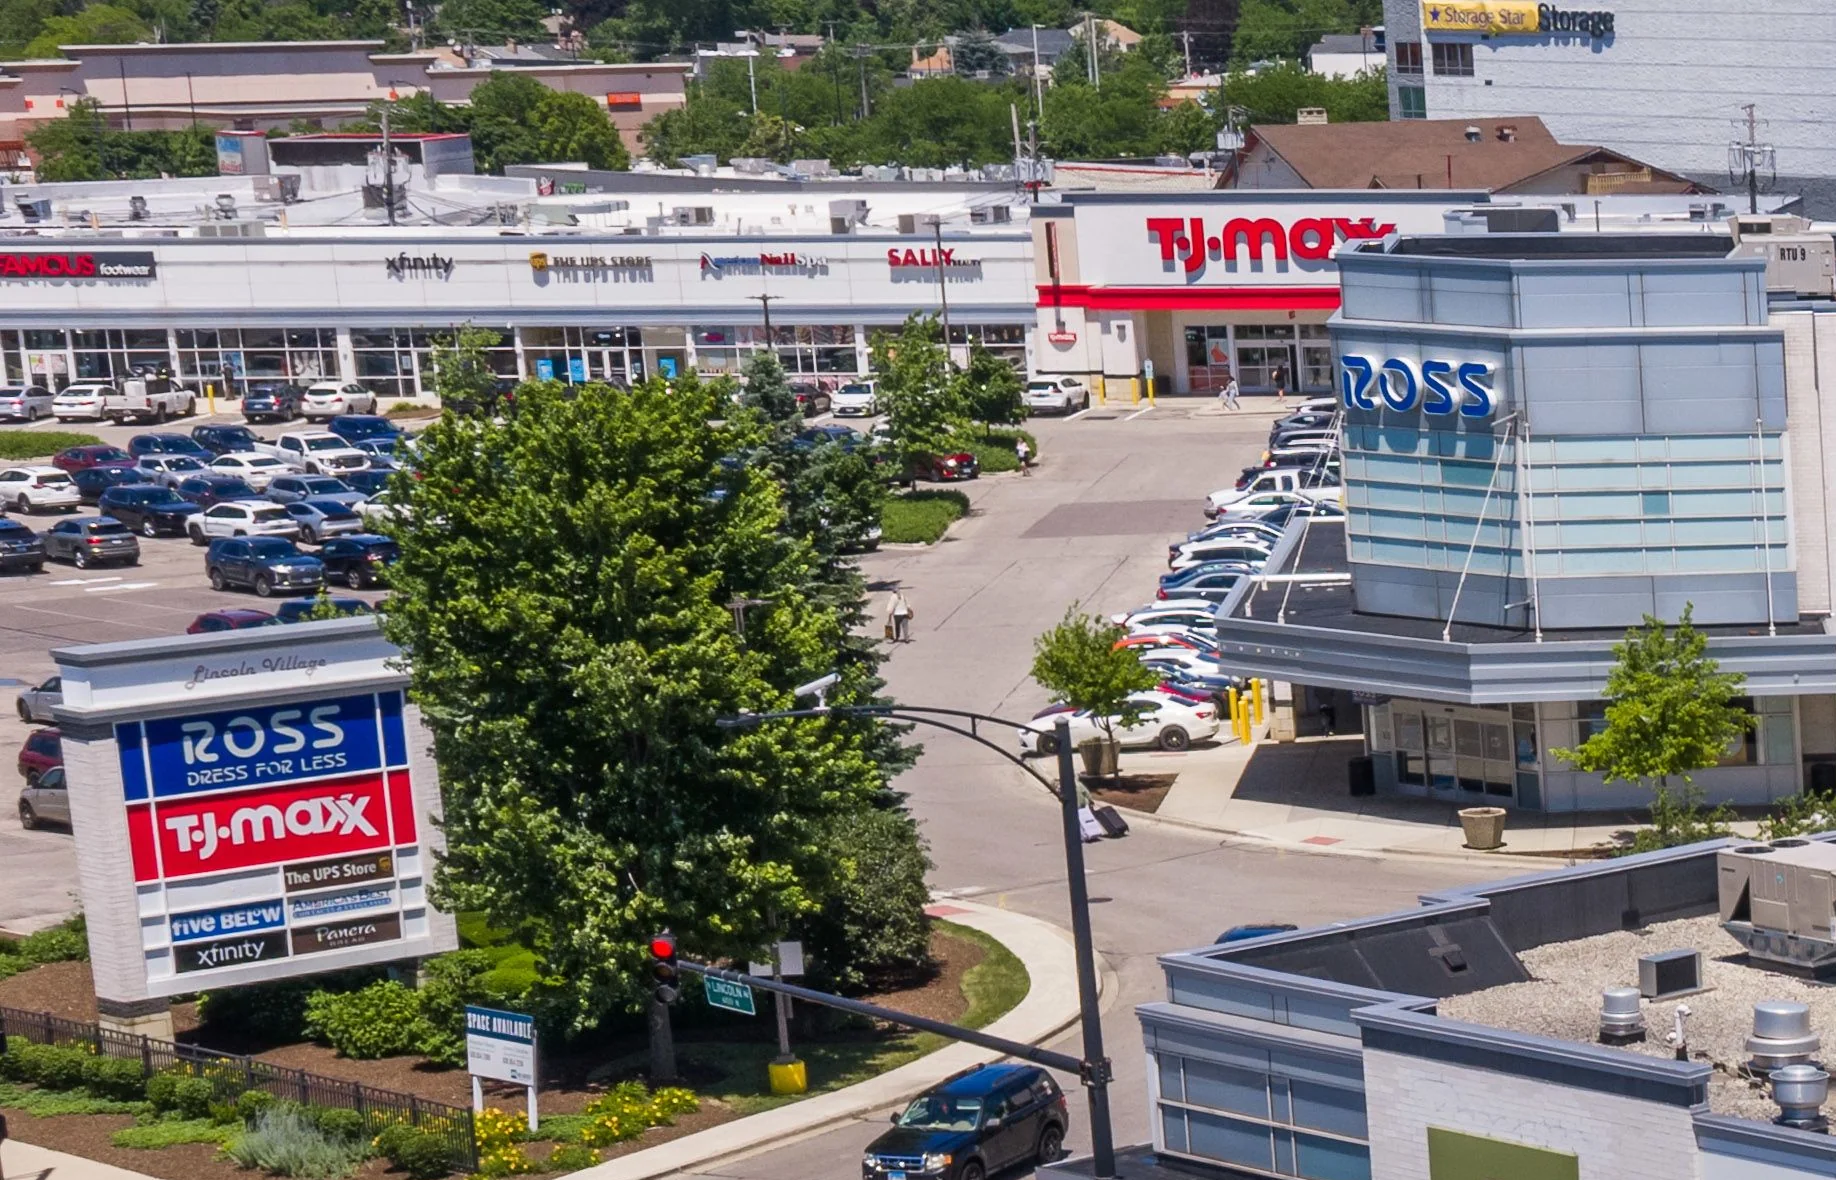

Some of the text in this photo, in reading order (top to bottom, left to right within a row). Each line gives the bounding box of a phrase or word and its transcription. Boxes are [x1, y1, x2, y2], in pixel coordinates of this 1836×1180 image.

[1445, 6, 1525, 27] Storage Star
[1538, 2, 1615, 38] Storage
[385, 252, 453, 272] xfinity
[553, 255, 652, 267] THE UPS STORE
[797, 254, 829, 268] Spa
[887, 248, 955, 267] SALLY
[1780, 247, 1806, 261] RTU 9
[100, 263, 150, 275] footwear
[1341, 354, 1496, 418] ROSS
[185, 655, 327, 690] Lincoln Village
[181, 704, 345, 765] ROSS
[187, 752, 348, 787] DRESS FOR LESS
[285, 861, 377, 886] The UPS Store
[172, 914, 217, 937] five
[315, 923, 377, 943] Panera
[197, 939, 265, 966] xfinity
[712, 981, 743, 998] LINCOLN
[467, 1012, 532, 1039] SPACE AVAILABLE
